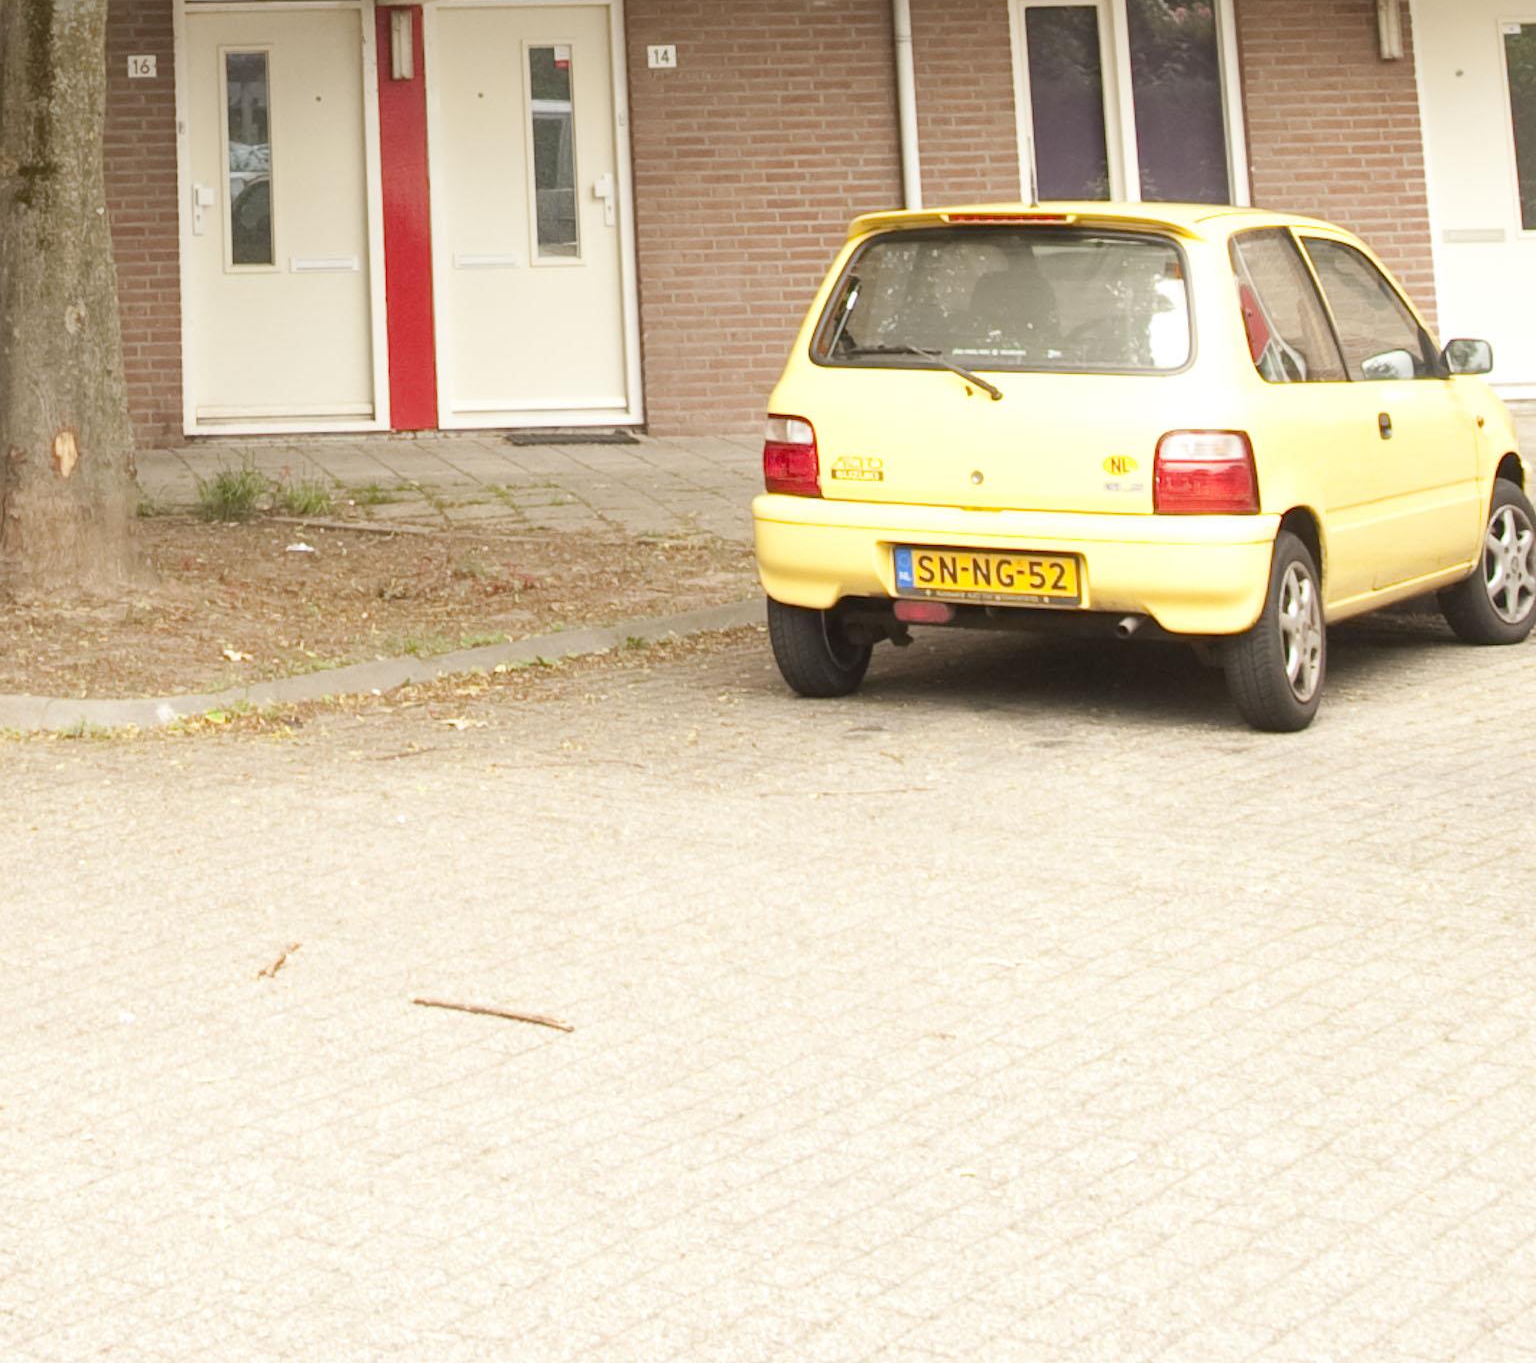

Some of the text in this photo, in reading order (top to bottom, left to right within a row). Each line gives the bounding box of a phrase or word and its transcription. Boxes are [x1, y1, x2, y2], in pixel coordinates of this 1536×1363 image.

[653, 49, 670, 65] 14
[132, 58, 150, 75] 16
[1111, 457, 1131, 474] NL
[917, 554, 1068, 591] SN-NG-52
